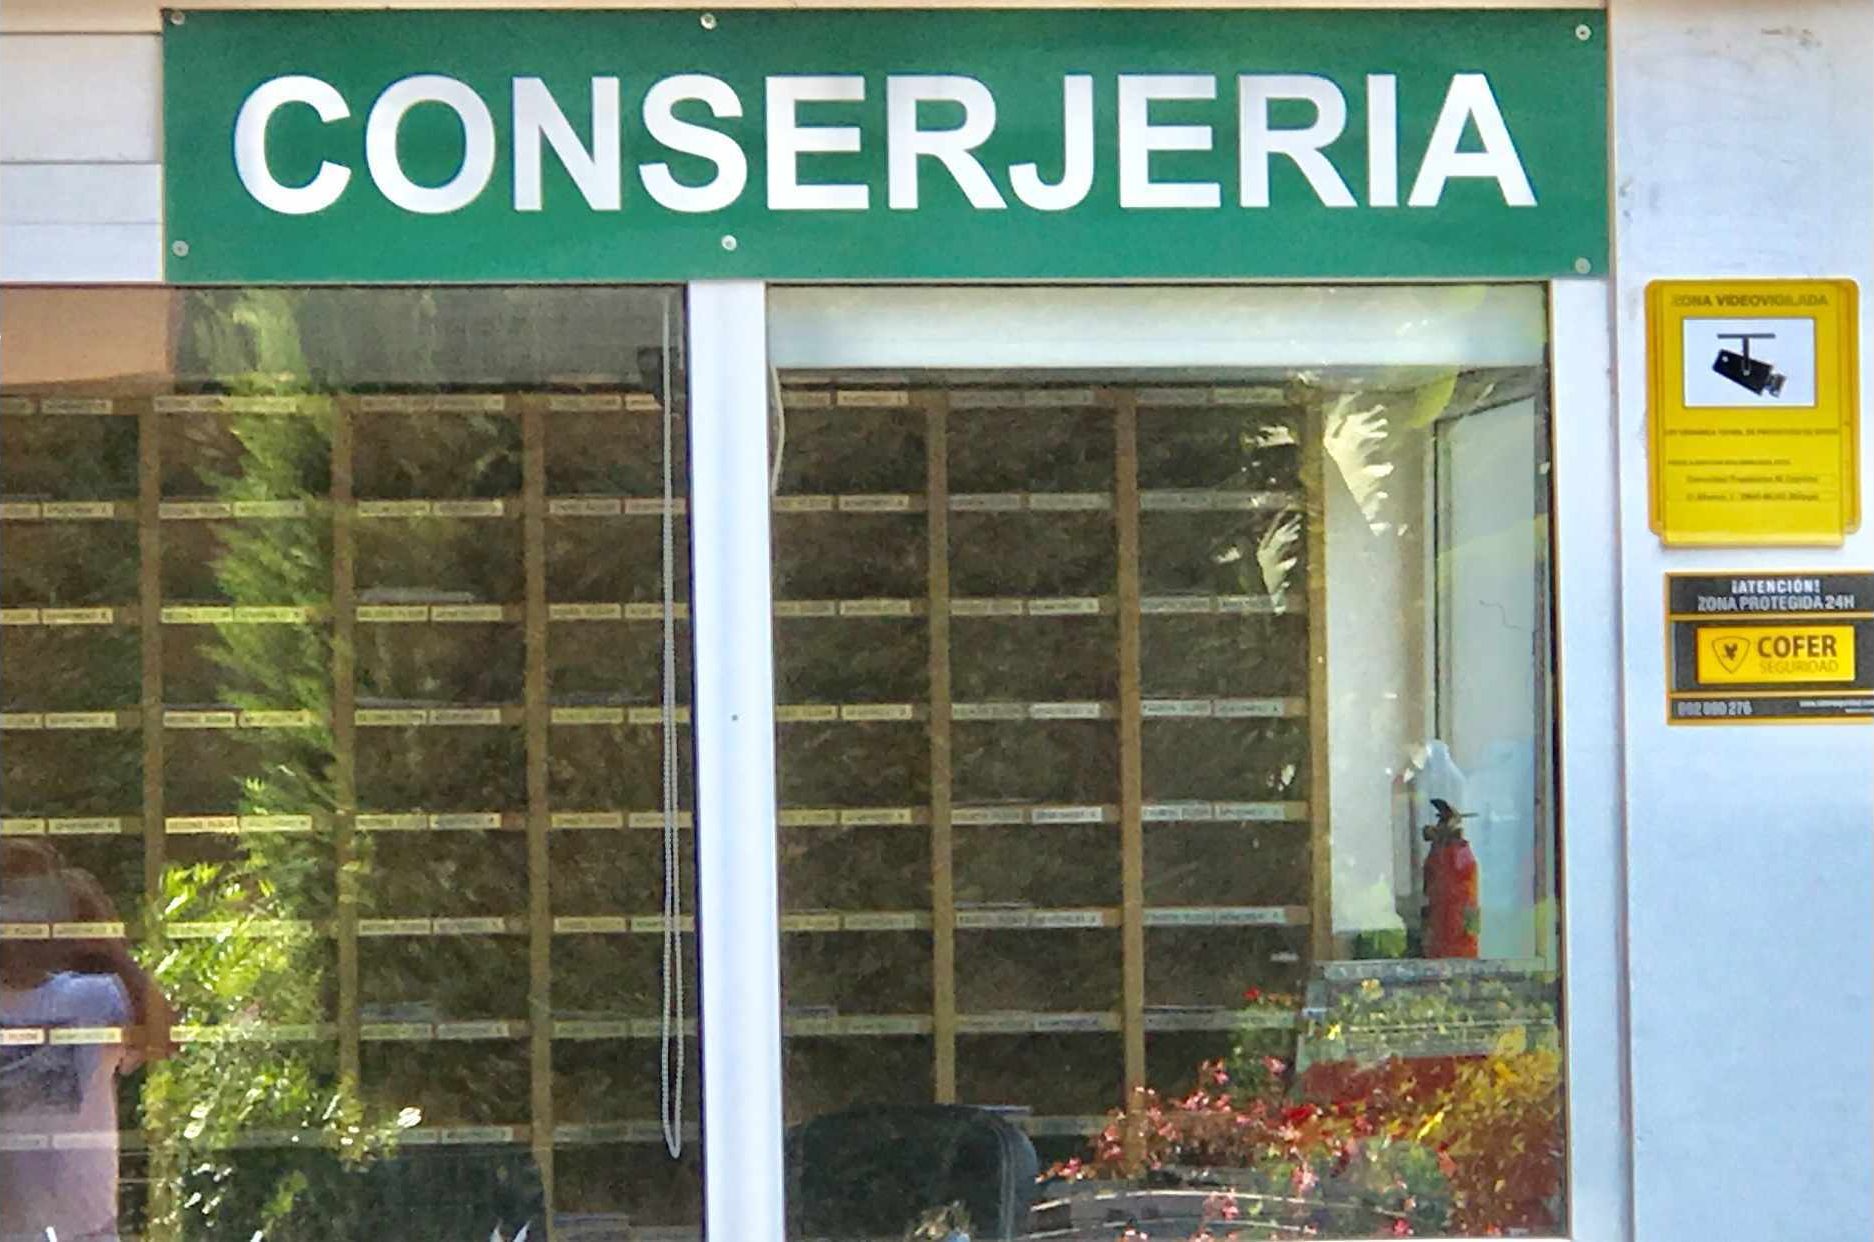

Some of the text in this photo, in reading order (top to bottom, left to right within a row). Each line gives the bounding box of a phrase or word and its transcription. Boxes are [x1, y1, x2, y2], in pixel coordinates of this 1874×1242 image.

[236, 74, 1535, 214] CONSERJERIA
[1673, 294, 1829, 306] ZONA VIDEOVIGILADA
[1698, 594, 1855, 611] ZONA PROTEGIDA 24H
[1757, 634, 1837, 658] COFER
[1758, 660, 1839, 674] SEGURIDAD
